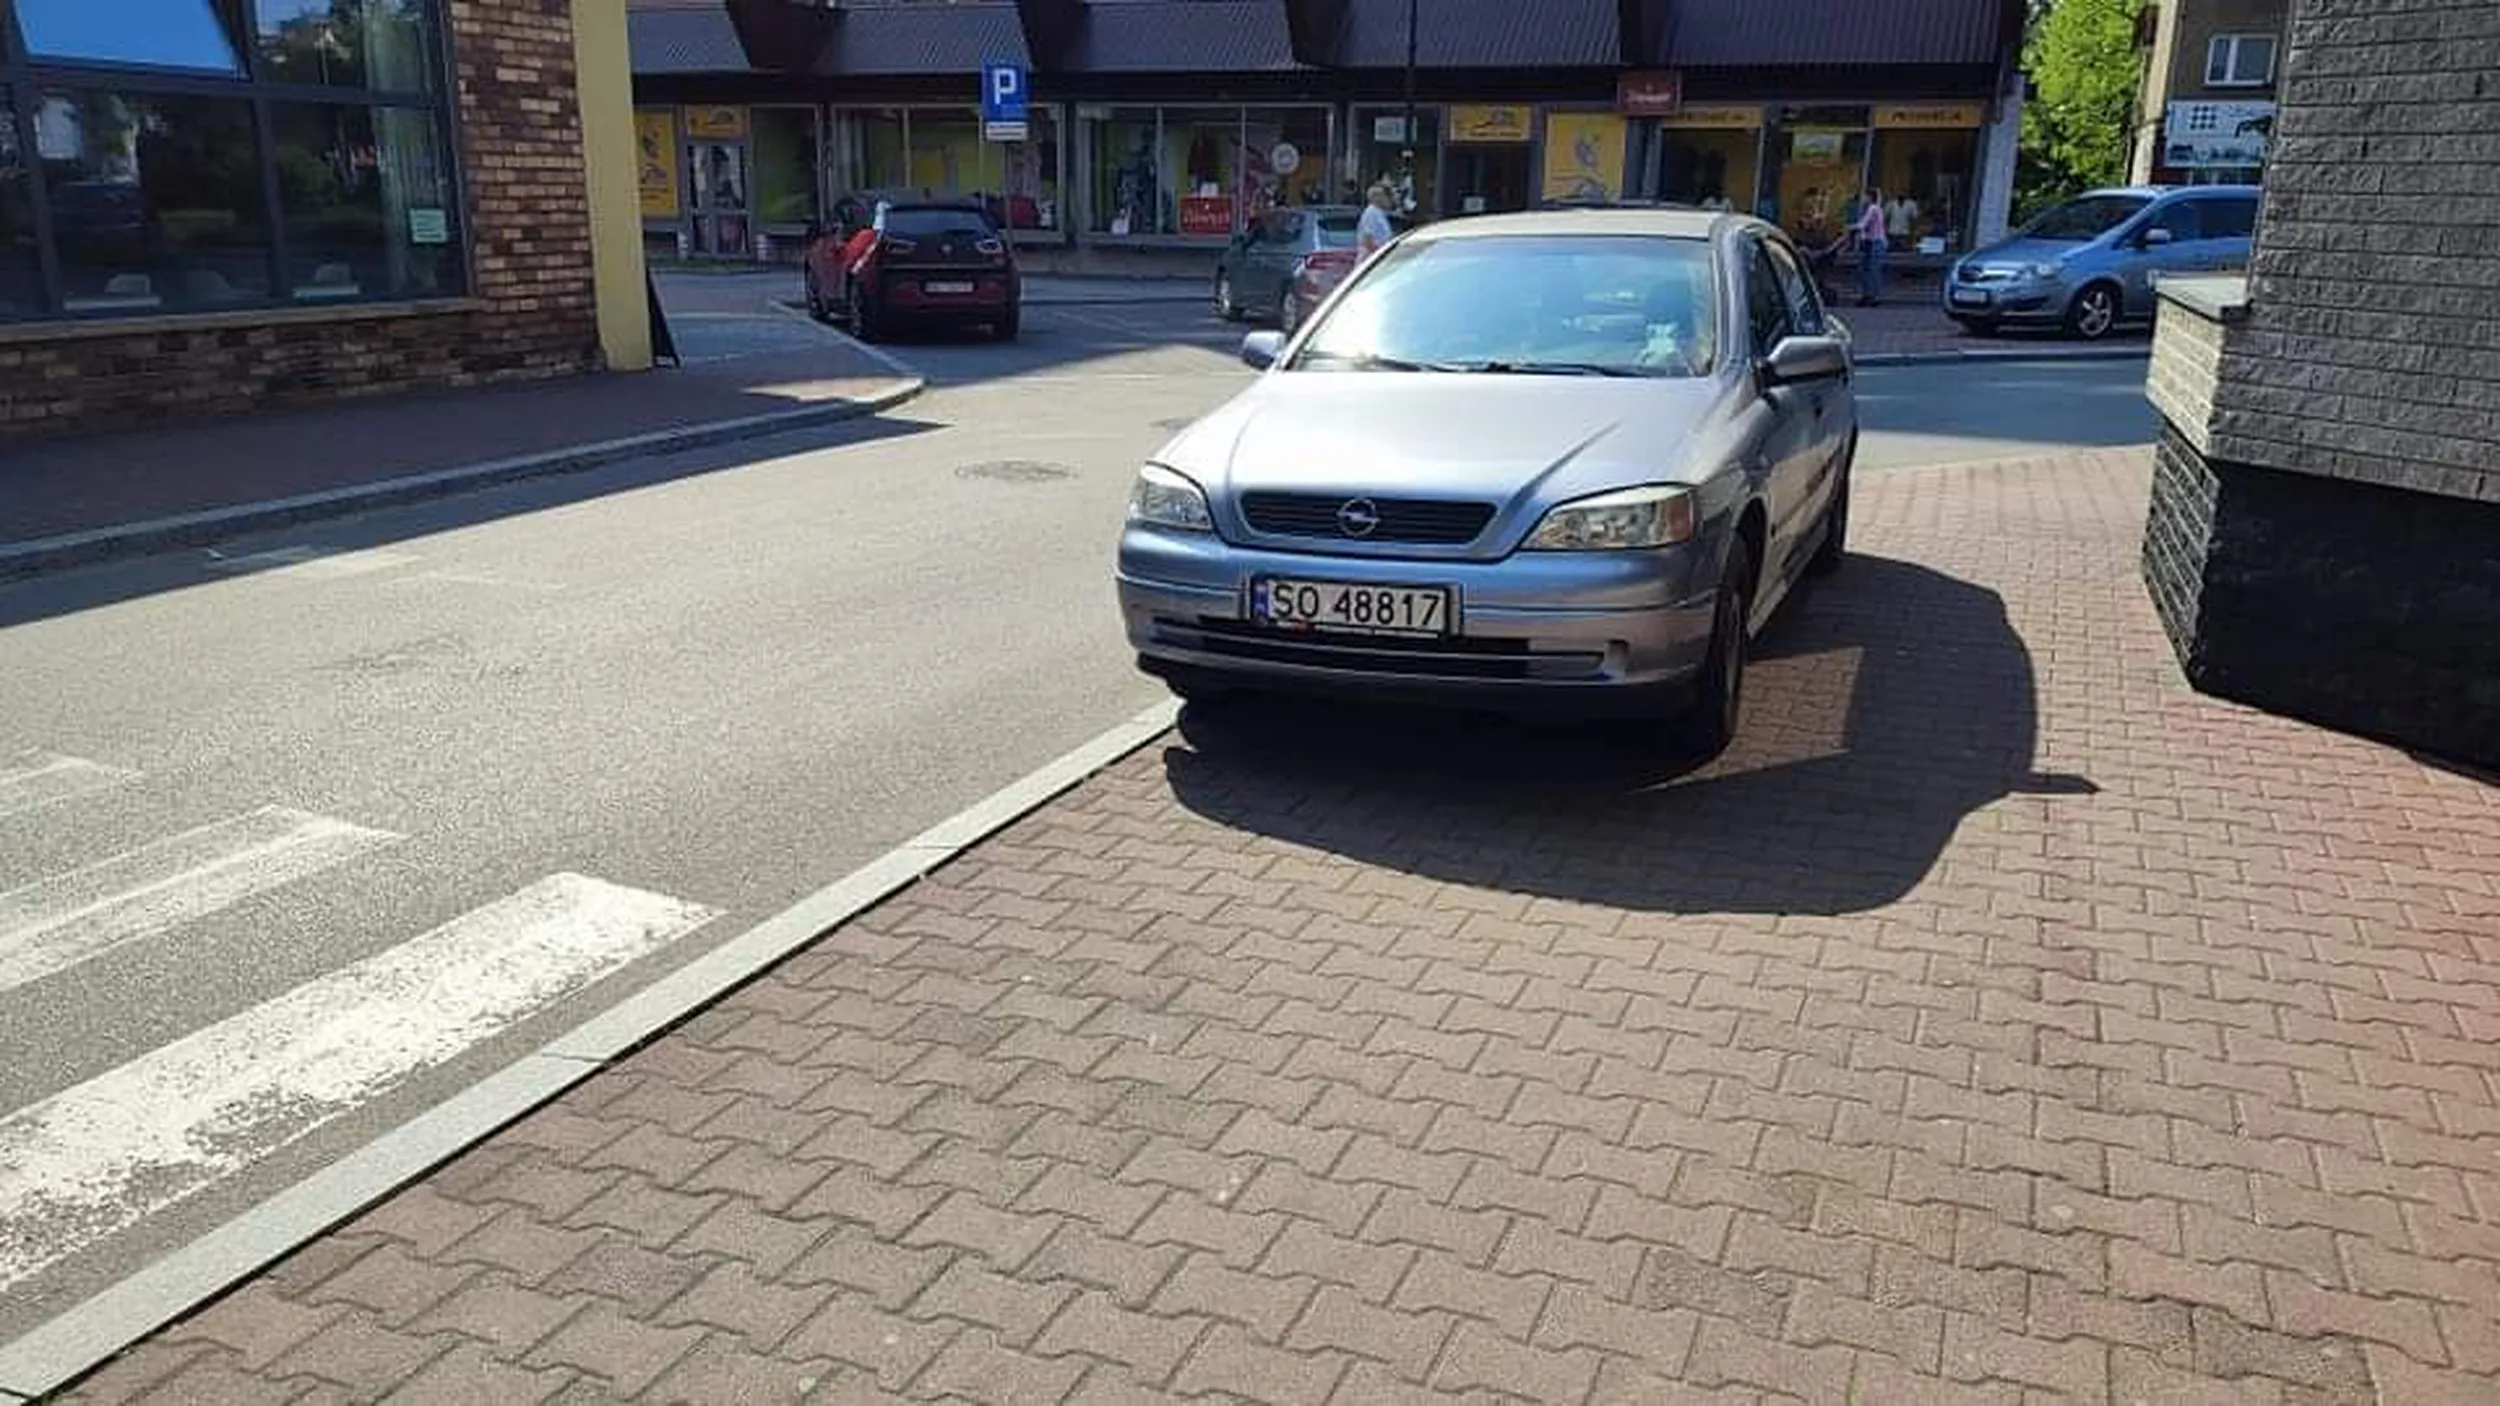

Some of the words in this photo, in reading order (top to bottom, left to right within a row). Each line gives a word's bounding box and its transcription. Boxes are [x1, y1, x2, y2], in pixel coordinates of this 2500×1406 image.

[994, 69, 1016, 104] P
[1273, 583, 1320, 619] SO
[1332, 588, 1441, 626] 48817
